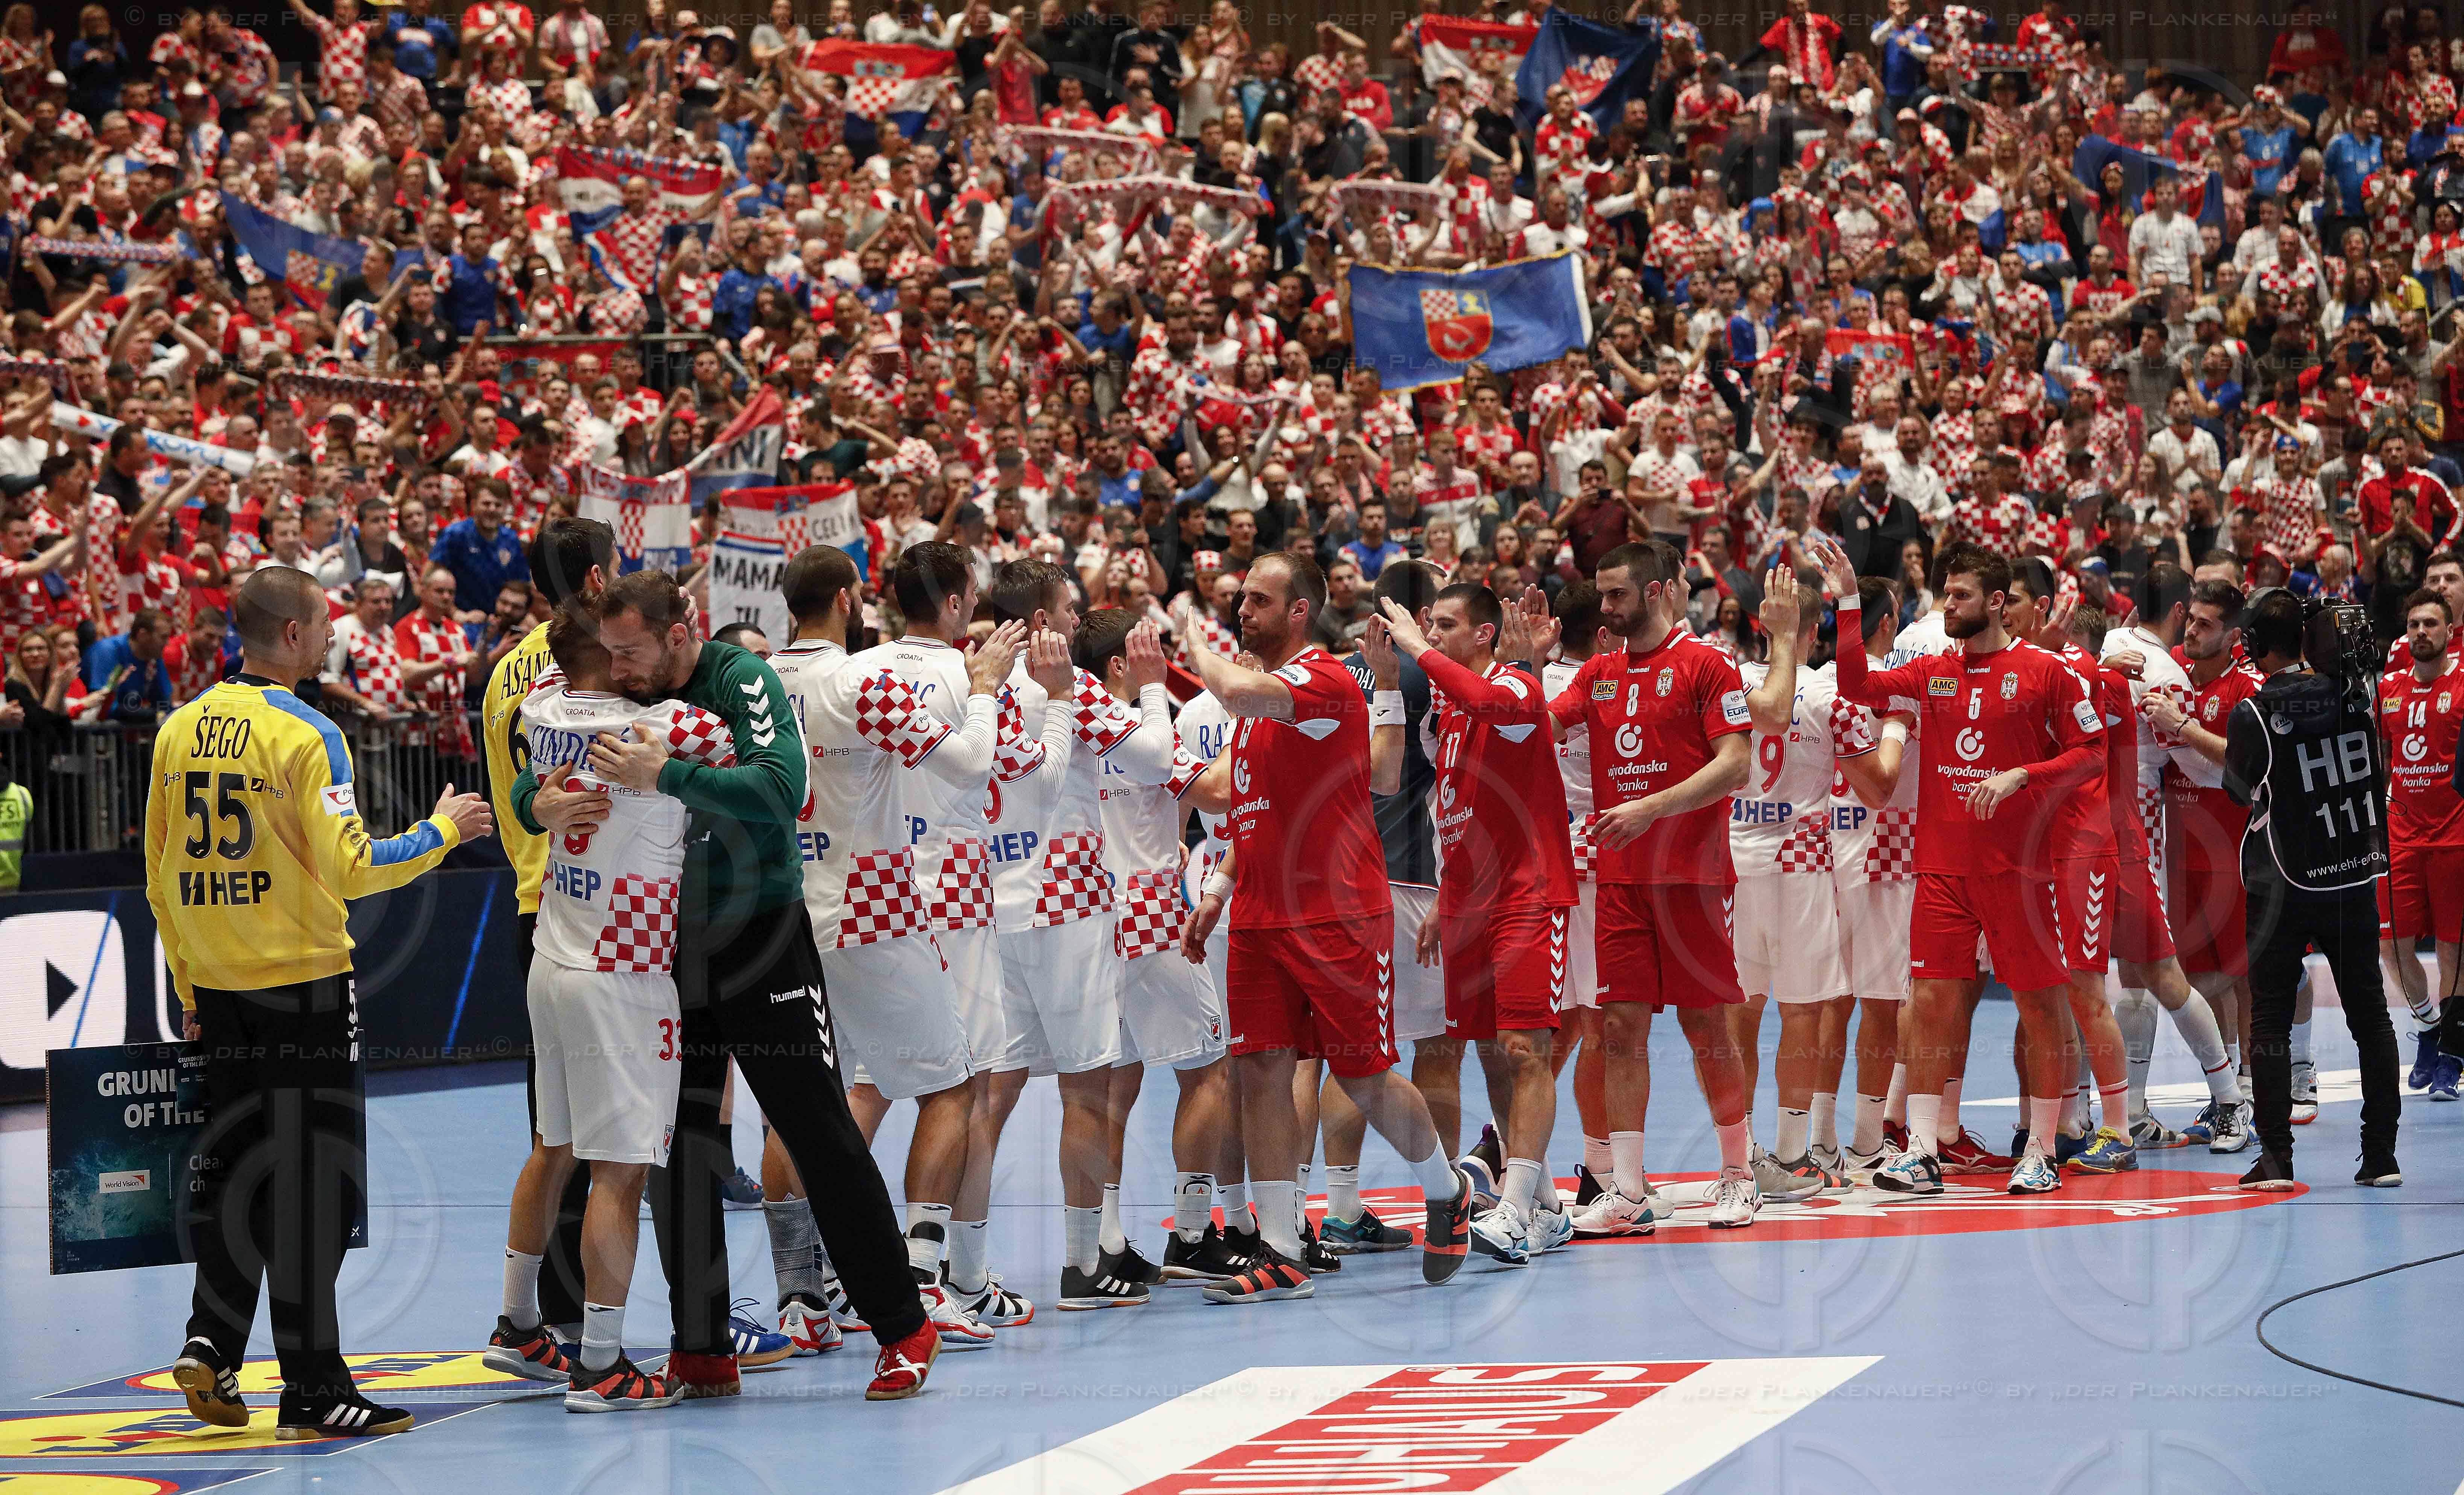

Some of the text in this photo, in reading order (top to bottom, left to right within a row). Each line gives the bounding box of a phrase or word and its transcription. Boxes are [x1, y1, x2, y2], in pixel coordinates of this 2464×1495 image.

[897, 653, 923, 662] CROATIA
[1627, 666, 1651, 674] hummel
[1967, 666, 1991, 674] hummel
[1626, 683, 1639, 717] 8
[1727, 707, 1749, 717] EUR
[1968, 688, 1983, 720] 5
[566, 708, 596, 717] CROATIA
[2408, 700, 2427, 728] 14
[191, 704, 251, 760] ŠEGO
[1199, 722, 1229, 759] RA
[825, 748, 850, 756] HPB
[1444, 732, 1461, 769] 17
[2296, 731, 2371, 792] HB
[1109, 788, 1130, 798] HPB
[1617, 778, 1649, 792] banka
[2402, 776, 2431, 787] banka
[184, 771, 256, 860] 55
[1744, 800, 1793, 824] HEP
[2315, 791, 2376, 838] 111
[797, 831, 831, 861] EP
[210, 870, 272, 906] HEP
[552, 860, 601, 902] HEP
[770, 986, 806, 1003] hummel
[124, 1103, 155, 1128] OF
[189, 1154, 223, 1171] Clea
[190, 1175, 206, 1192] ch
